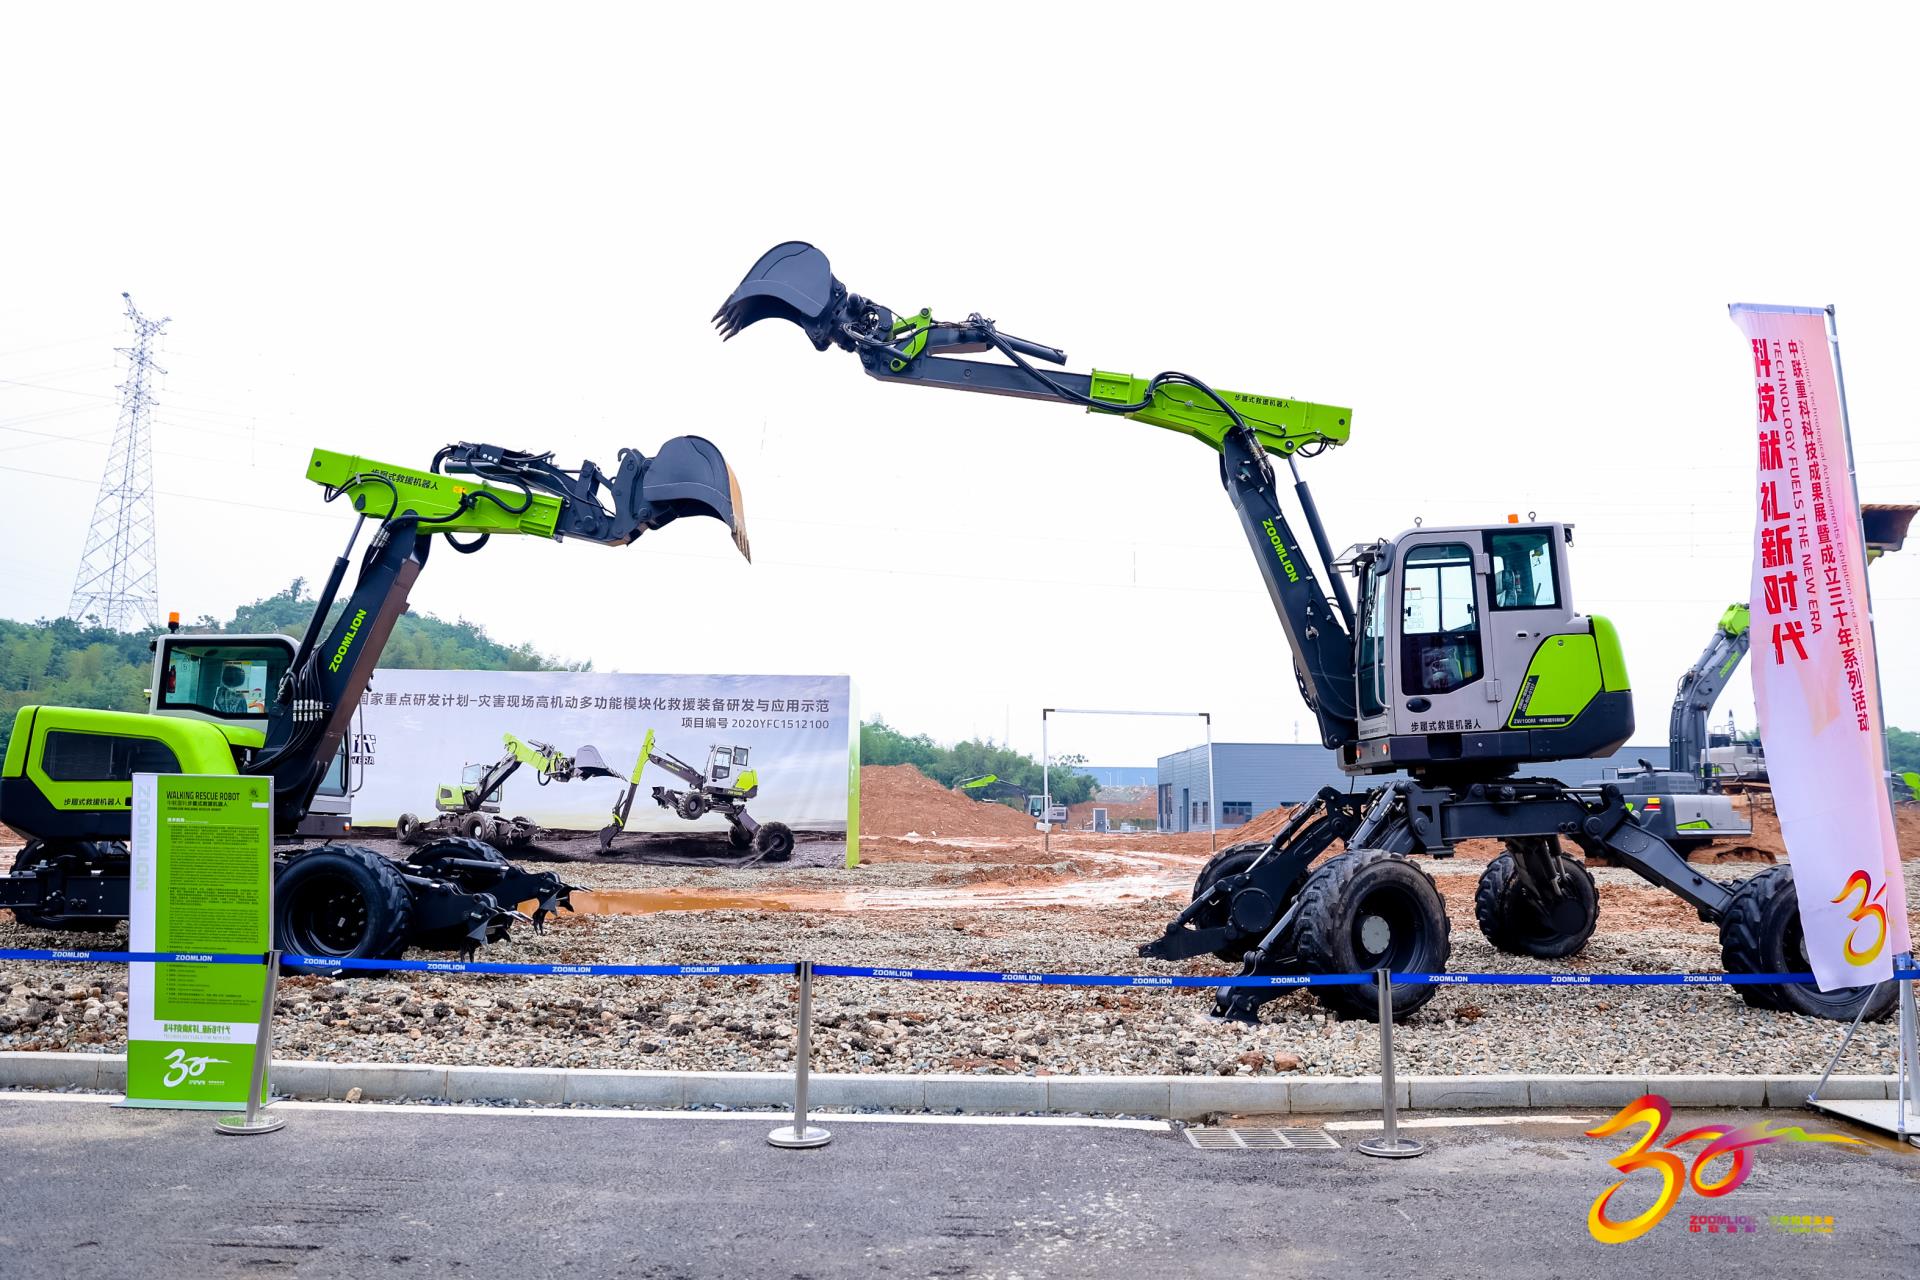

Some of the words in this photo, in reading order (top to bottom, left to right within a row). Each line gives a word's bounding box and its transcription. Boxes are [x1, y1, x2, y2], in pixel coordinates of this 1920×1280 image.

[1234, 393, 1291, 410] 步履式救援机器人
[1773, 339, 1796, 451] TECHNOLOGY
[1788, 457, 1805, 510] FUELS
[1798, 339, 1812, 388] Zoomlion
[1810, 391, 1825, 462] Technological
[1822, 462, 1841, 539] Achievements
[1836, 542, 1852, 595] Exhibition
[1752, 339, 1809, 665] 科技献礼新时代
[1788, 339, 1870, 732] 中联重科科技成果展暨成立三十年系列活动
[1796, 516, 1810, 549] THE
[1261, 518, 1300, 584] ZOOMLION
[1802, 554, 1817, 594] NEW
[1808, 600, 1823, 634] ERA
[328, 608, 368, 673] ZOOMLION
[681, 717, 729, 729] 项目编号
[731, 718, 830, 730] 2020YFC1512100
[1410, 718, 1482, 733] 步履式救援机器人
[166, 791, 194, 799] WALKING
[195, 792, 219, 800] RESCUE
[220, 793, 240, 801] ROBOT
[136, 785, 151, 891] ZOOMLION
[1830, 869, 1887, 967] 3
[52, 951, 90, 959] ZOOMLION
[175, 954, 213, 962] ZOOMLION
[303, 958, 341, 966] ZOOMLION
[427, 963, 466, 971] ZOOMLION
[872, 969, 913, 977] ZOOMLION
[1002, 974, 1042, 982] ZOOMLION
